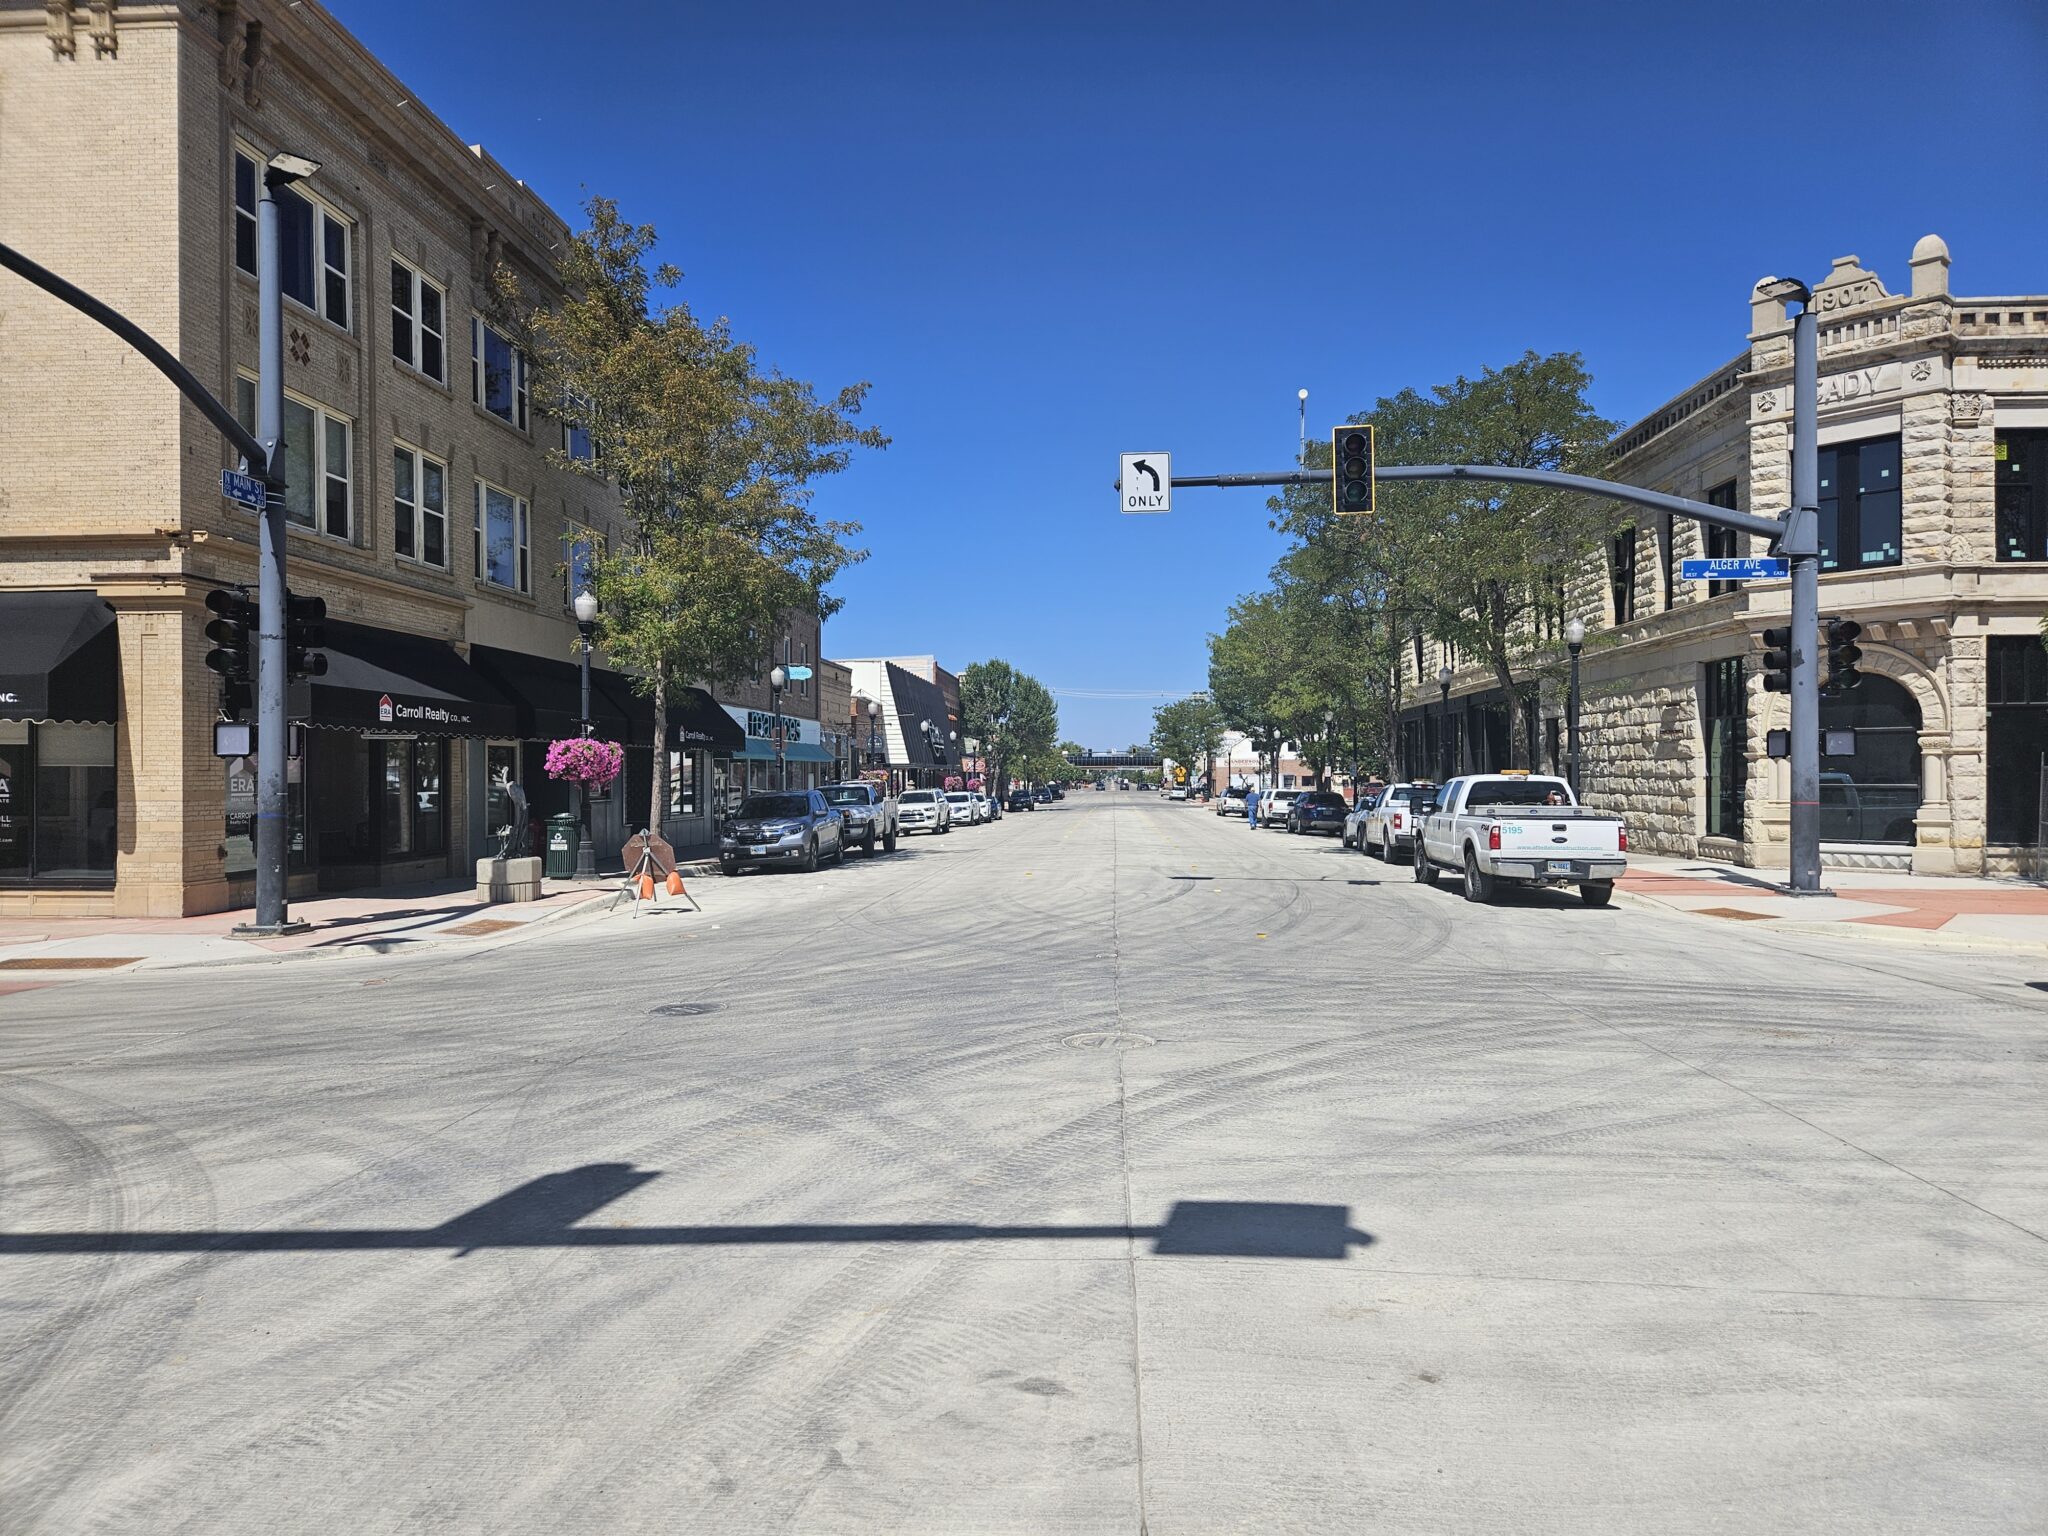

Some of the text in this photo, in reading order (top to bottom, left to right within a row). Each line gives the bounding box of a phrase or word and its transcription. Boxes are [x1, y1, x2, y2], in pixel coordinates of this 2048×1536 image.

[225, 472, 230, 484] N
[233, 474, 251, 491] MAIN
[1128, 495, 1164, 507] ONLY
[1709, 559, 1761, 570] ALGER AVE
[395, 704, 424, 719] Carroll
[425, 706, 450, 724] Realty
[751, 711, 801, 741] mauces
[230, 778, 254, 792] ERA
